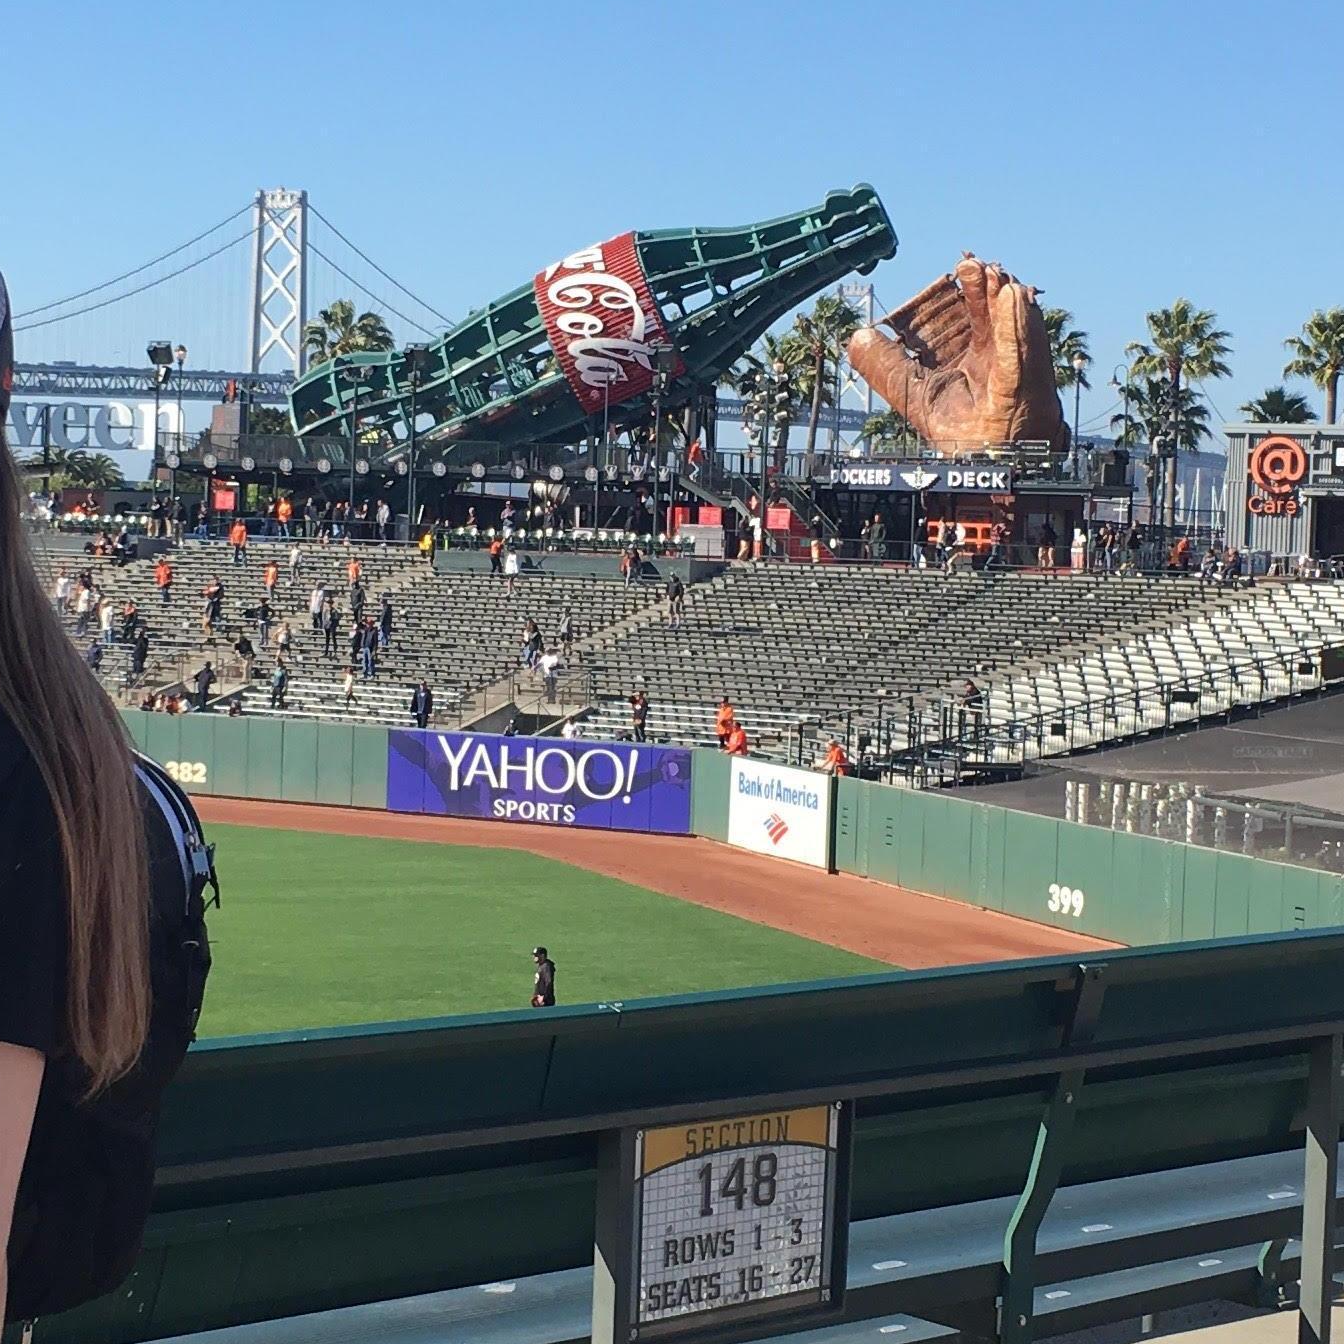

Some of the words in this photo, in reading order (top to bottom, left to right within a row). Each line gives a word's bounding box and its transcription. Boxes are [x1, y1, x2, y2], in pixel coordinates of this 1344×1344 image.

[830, 470, 891, 485] DOCKERS
[947, 471, 1006, 488] DECK
[166, 761, 207, 783] 382
[438, 736, 638, 804] YAHOO!
[493, 798, 576, 822] SPORTS
[739, 771, 762, 798] Bank
[764, 779, 774, 800] of
[775, 780, 818, 810] America
[1048, 883, 1084, 917] 399
[685, 1115, 790, 1156] SECTION
[699, 1153, 778, 1216] 148
[664, 1229, 735, 1268] ROWS
[755, 1224, 762, 1250] 1
[791, 1218, 803, 1245] 3
[648, 1272, 721, 1311] SEATS
[739, 1265, 763, 1295] 16
[790, 1255, 816, 1284] 27
